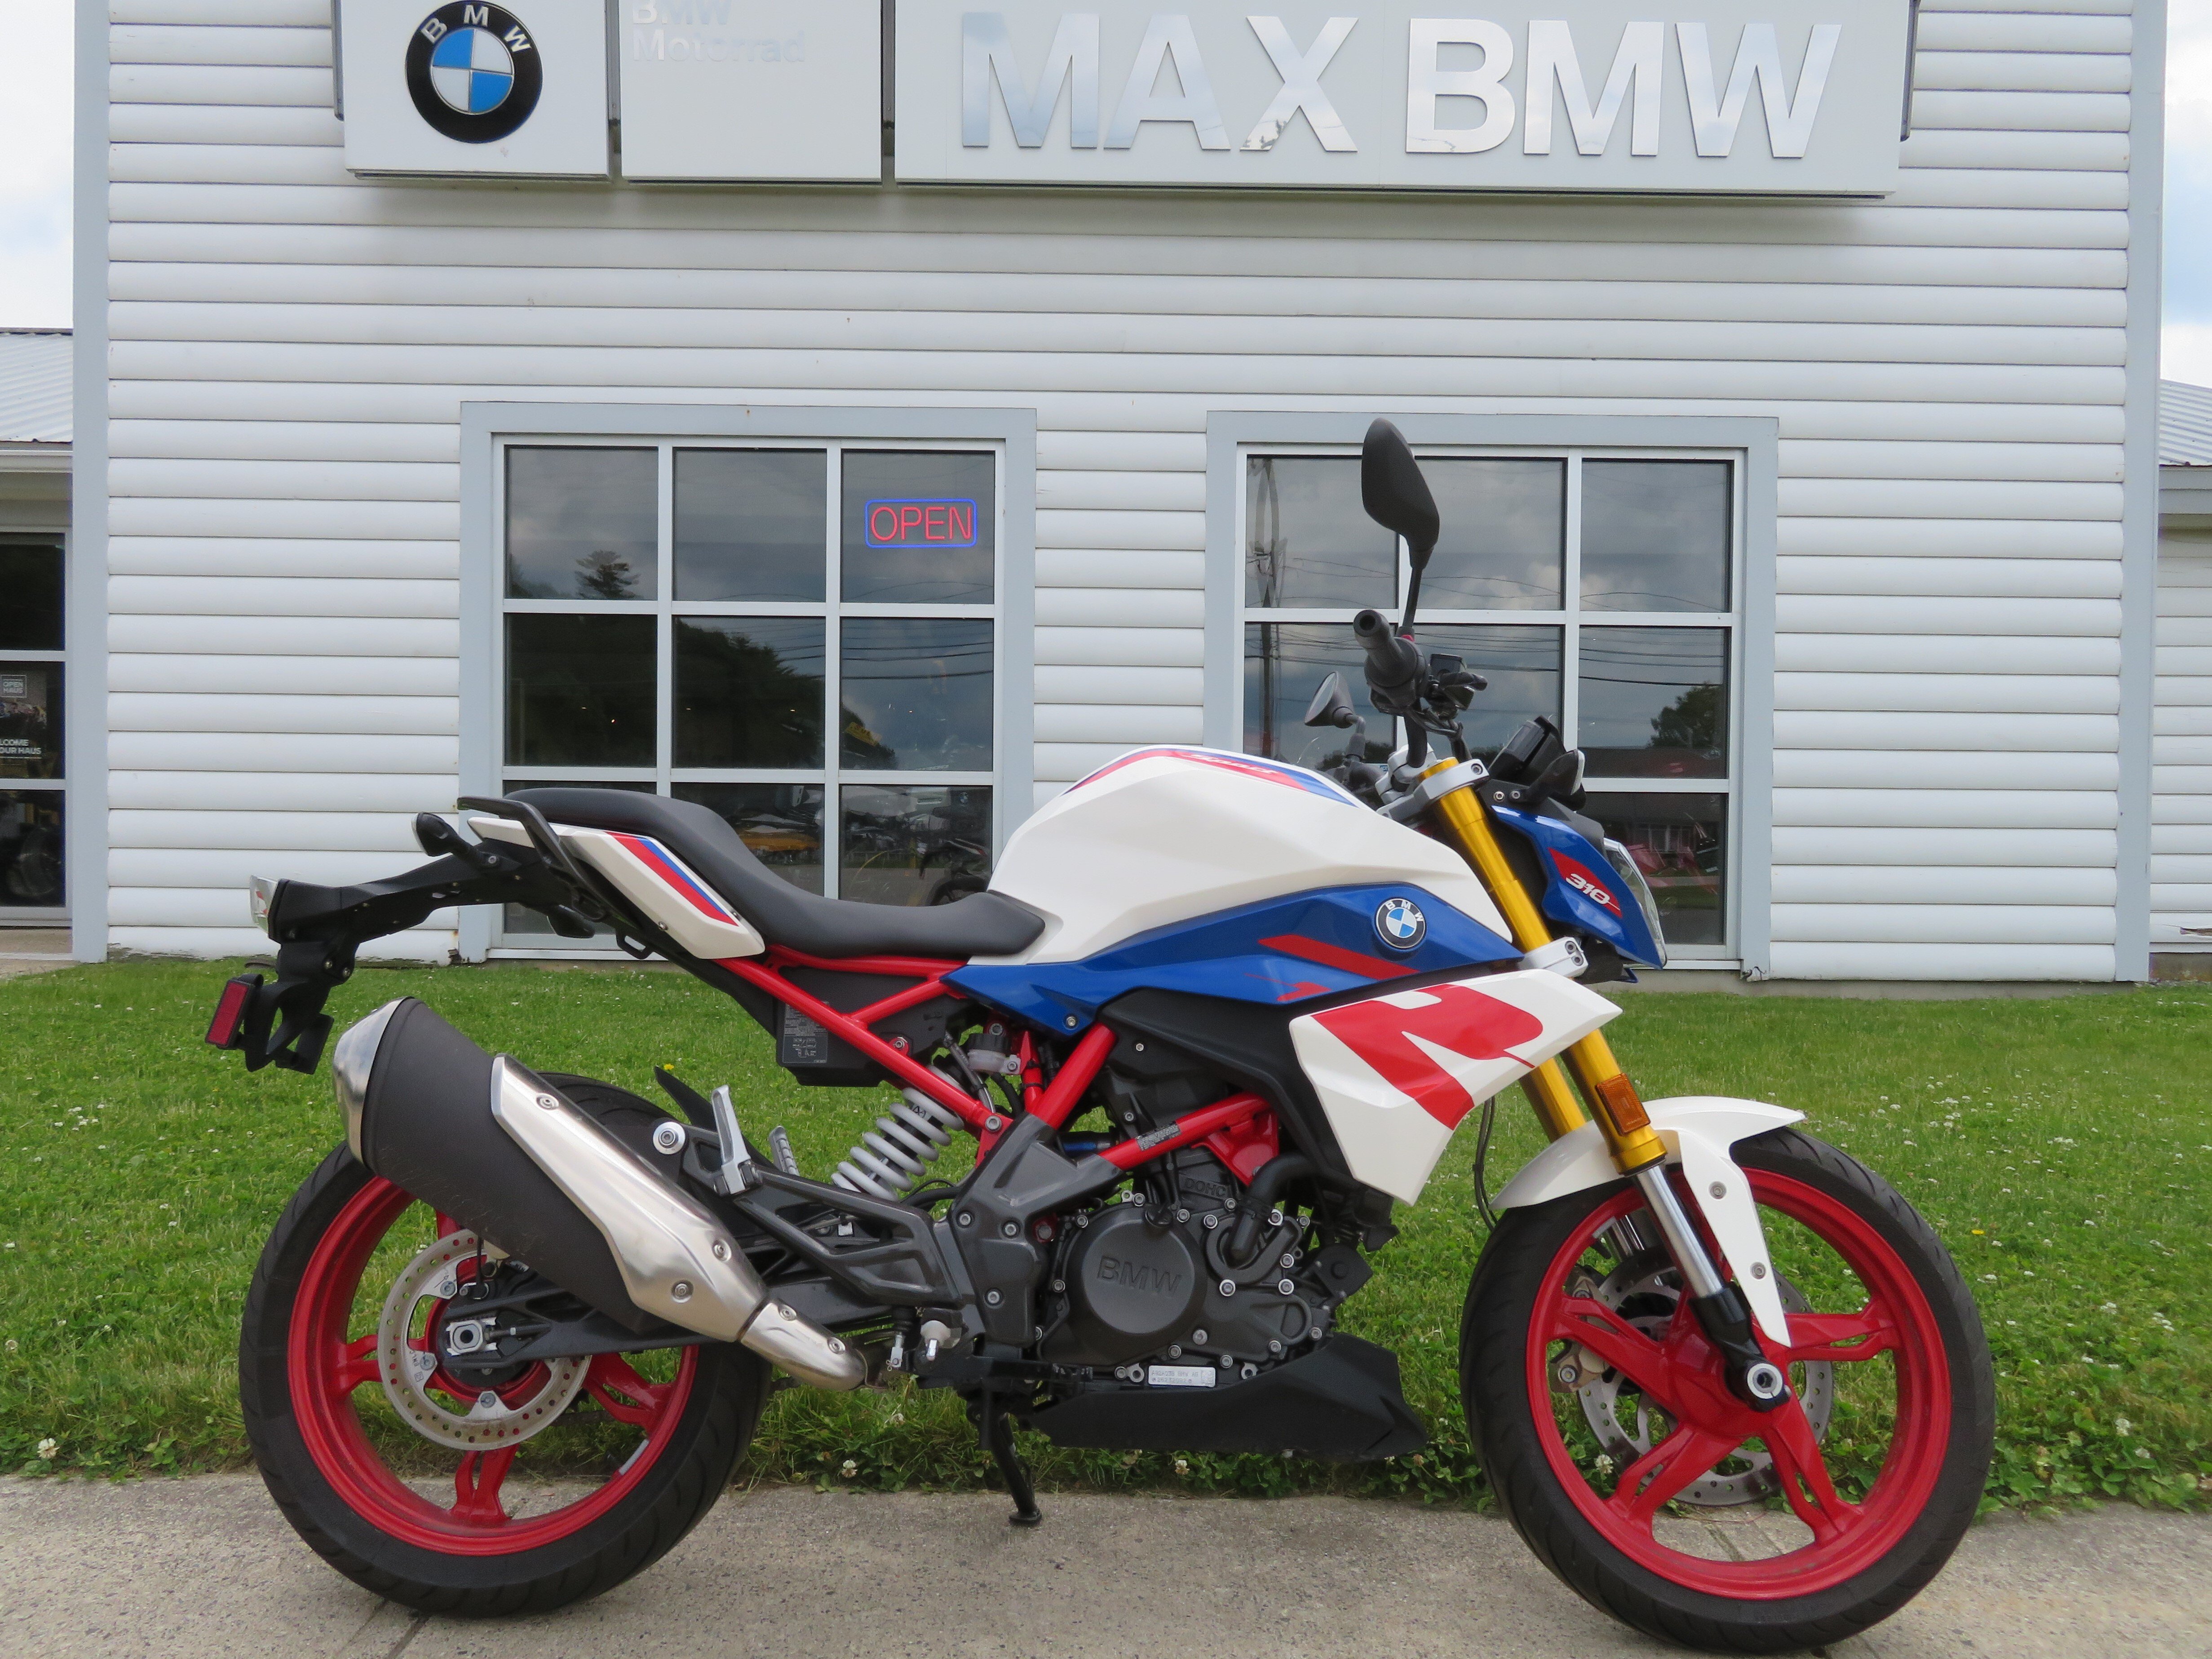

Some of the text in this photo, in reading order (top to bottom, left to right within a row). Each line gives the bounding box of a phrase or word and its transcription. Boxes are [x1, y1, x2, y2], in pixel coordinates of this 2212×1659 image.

[632, 0, 732, 24] BMW
[421, 5, 532, 53] BMW
[632, 29, 805, 62] Motorrad
[962, 12, 1842, 158] MAX BMW
[871, 506, 972, 541] OPEN
[1566, 873, 1610, 904] 310
[1385, 900, 1424, 921] BMW
[1185, 1177, 1226, 1197] DOHC
[1097, 1256, 1181, 1292] BMW
